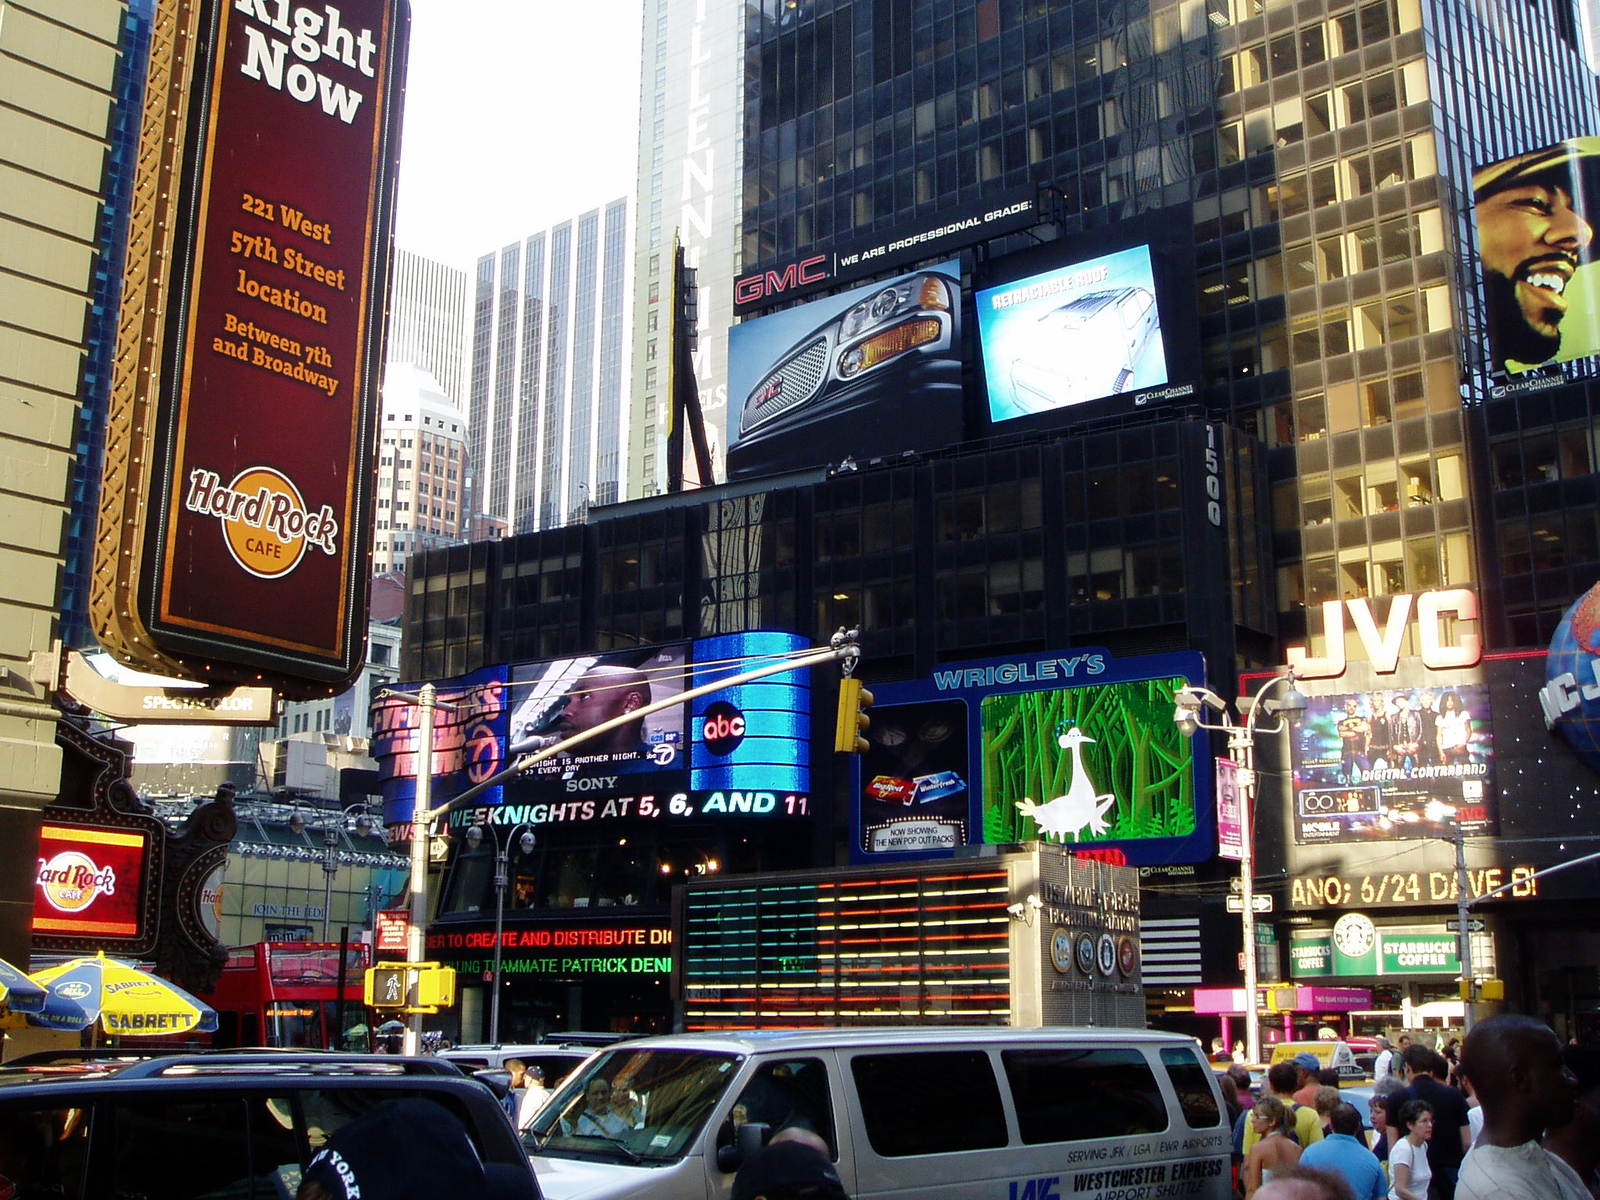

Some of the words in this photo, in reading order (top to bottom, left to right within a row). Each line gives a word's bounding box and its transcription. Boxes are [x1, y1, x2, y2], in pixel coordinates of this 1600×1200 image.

[242, 193, 275, 222] 221
[280, 204, 332, 245] West
[840, 254, 859, 267] WE
[861, 246, 886, 261] ARE
[888, 216, 982, 252] PROFESSIONAL
[984, 200, 1033, 223] GRADE:
[230, 230, 278, 265] 57th
[283, 247, 346, 291] Street
[735, 254, 826, 304] GMC
[991, 276, 1073, 310] RETRACTABLE
[1078, 265, 1108, 288] ROOF
[236, 269, 328, 325] location
[224, 313, 301, 357] Between
[305, 345, 333, 369] 7th
[213, 337, 249, 361] and
[252, 347, 340, 396] Broadway
[1206, 424, 1221, 527] 1500
[186, 468, 269, 529] Hard
[265, 491, 339, 555] Rock
[245, 538, 282, 559] CAFE
[1286, 588, 1481, 679] JVC
[933, 653, 1106, 691] WRIGLEY'S
[143, 695, 254, 711] SPECTACOLOR
[703, 714, 745, 740] abc
[538, 766, 562, 775] EVERY
[565, 764, 581, 772] DAY
[562, 758, 571, 766] IS
[574, 754, 609, 765] ANOTHER
[612, 752, 641, 761] NIGHT.
[566, 776, 618, 792] SONY
[920, 779, 956, 793] Winterfresh
[450, 801, 595, 828] WEEKNIGHTS
[601, 797, 634, 819] AT
[639, 796, 660, 818] 5,
[669, 793, 694, 816] 6,
[702, 791, 776, 813] AND
[875, 838, 888, 847] THE
[888, 837, 904, 847] NEW
[904, 837, 918, 846] POP
[918, 836, 932, 845] OUT
[890, 828, 906, 837] NOW
[906, 826, 938, 836] SHOWING
[37, 858, 72, 885] ard
[71, 864, 115, 895] Rock
[1360, 873, 1421, 904] 6/24
[1429, 868, 1502, 900] DAVE
[253, 903, 278, 915] JOIN
[280, 905, 301, 917] THE
[448, 934, 463, 948] TO
[465, 932, 518, 948] CREATE
[519, 931, 551, 947] AND
[554, 929, 646, 947] DISTRIBUTE
[1292, 945, 1331, 958] STARBUCKS
[1383, 941, 1456, 955] STARBUCKS
[484, 958, 558, 974] TAMMATE
[562, 957, 628, 973] PATRICK
[631, 957, 672, 973] DEN
[1298, 957, 1324, 969] COFFEE
[1397, 953, 1446, 966] COFFEE
[105, 980, 157, 995] SABRETT
[107, 1012, 194, 1030] SABRETT
[1066, 1147, 1107, 1163] SERVING
[1109, 1147, 1125, 1159] JFK
[1133, 1144, 1151, 1156] LGA
[1160, 1141, 1180, 1153] EWR
[1181, 1135, 1223, 1149] AIRPORTS
[329, 1149, 361, 1200] YORK
[1073, 1165, 1165, 1193] WESTCHESTER
[1171, 1158, 1223, 1178] EXPRESS
[1156, 1178, 1205, 1197] SHUTTLE
